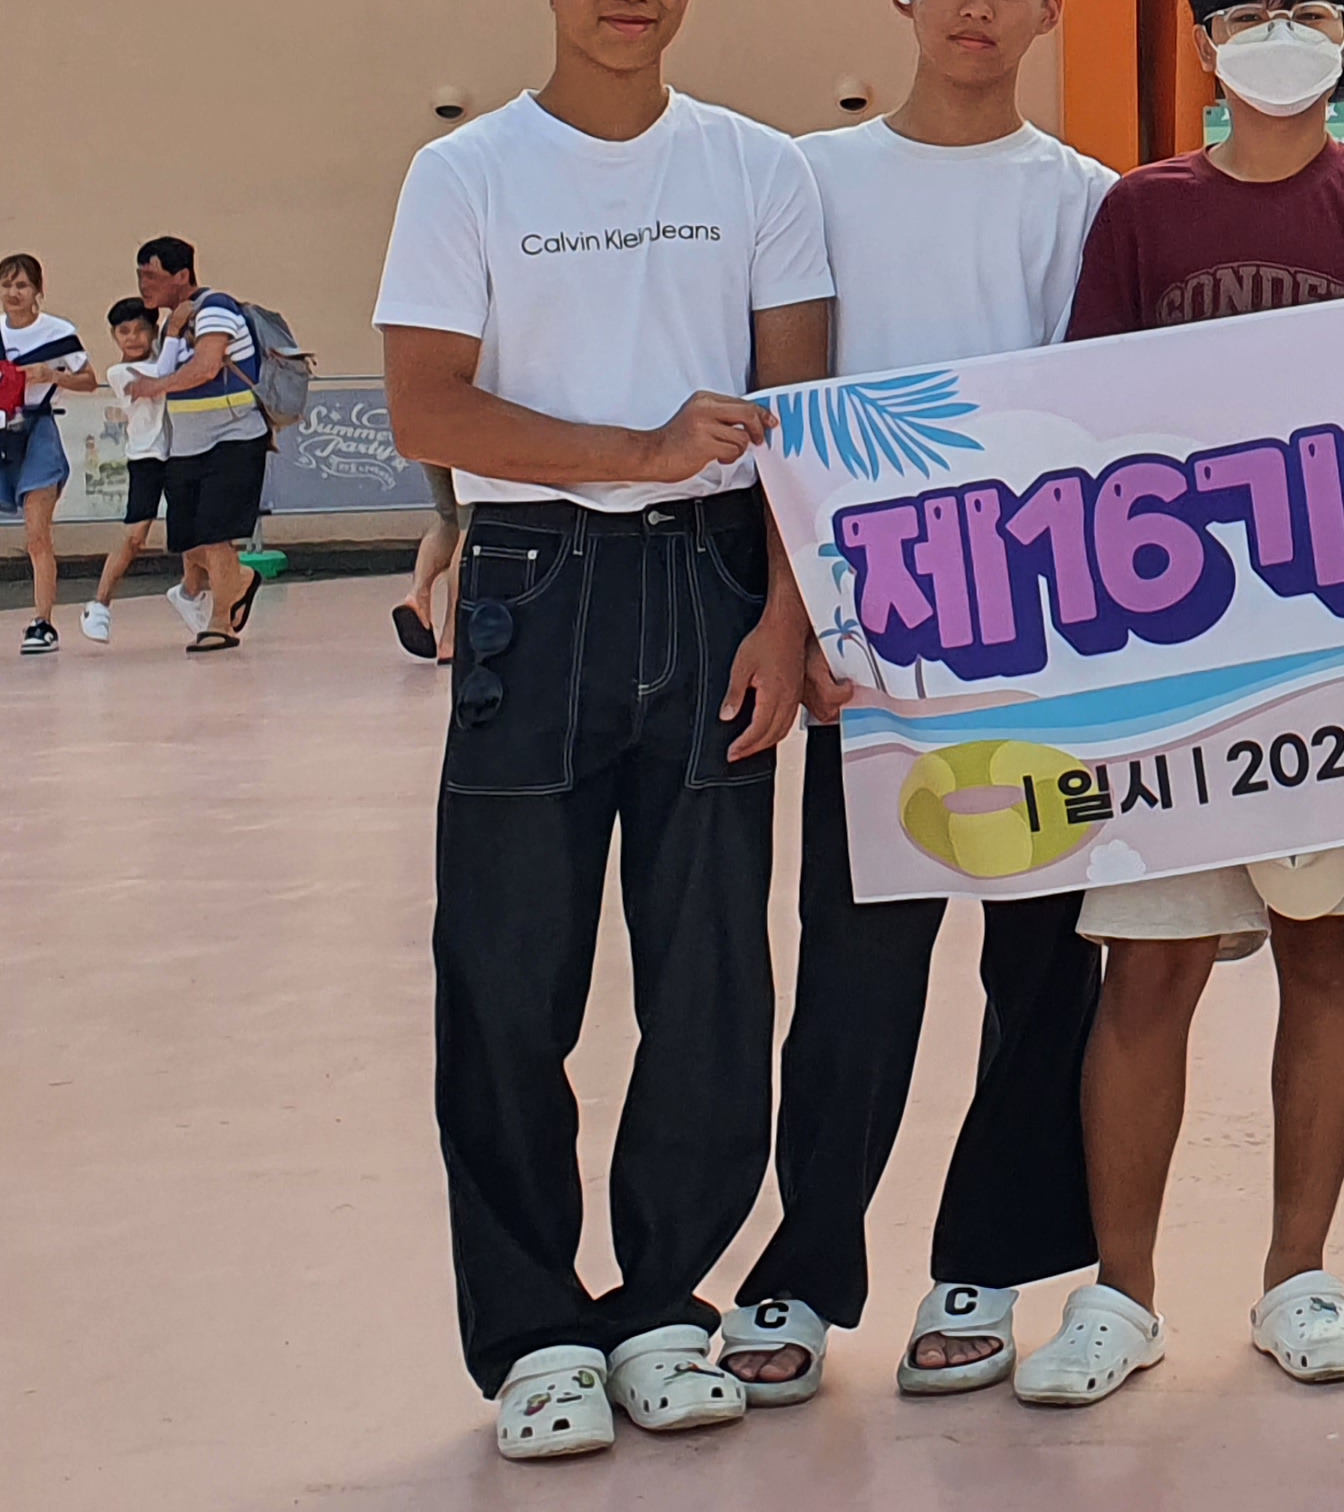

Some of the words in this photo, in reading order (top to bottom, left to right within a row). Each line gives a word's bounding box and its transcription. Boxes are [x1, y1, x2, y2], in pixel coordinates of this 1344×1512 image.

[521, 231, 600, 256] Calvin
[650, 220, 721, 241] Jeans
[1056, 753, 1173, 826] 일시
[753, 1301, 789, 1329] C
[944, 1286, 979, 1316] C
